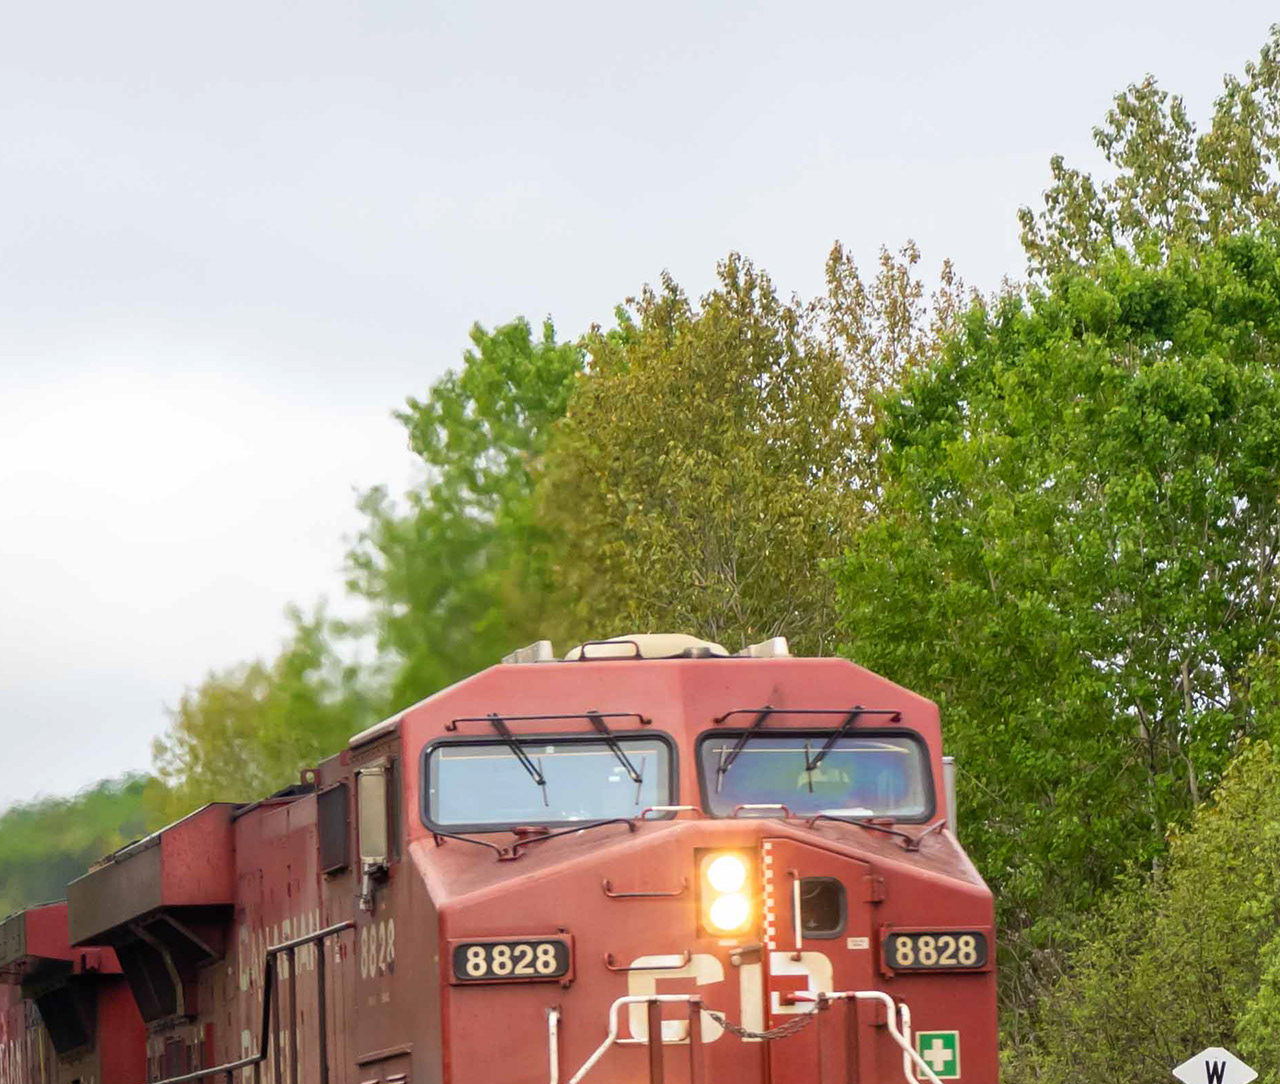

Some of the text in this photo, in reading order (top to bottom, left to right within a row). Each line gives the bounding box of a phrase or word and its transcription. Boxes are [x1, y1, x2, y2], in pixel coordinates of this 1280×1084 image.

[361, 918, 395, 980] 8828
[466, 943, 557, 977] 8828
[895, 935, 977, 966] 8828
[628, 951, 834, 1044] CP
